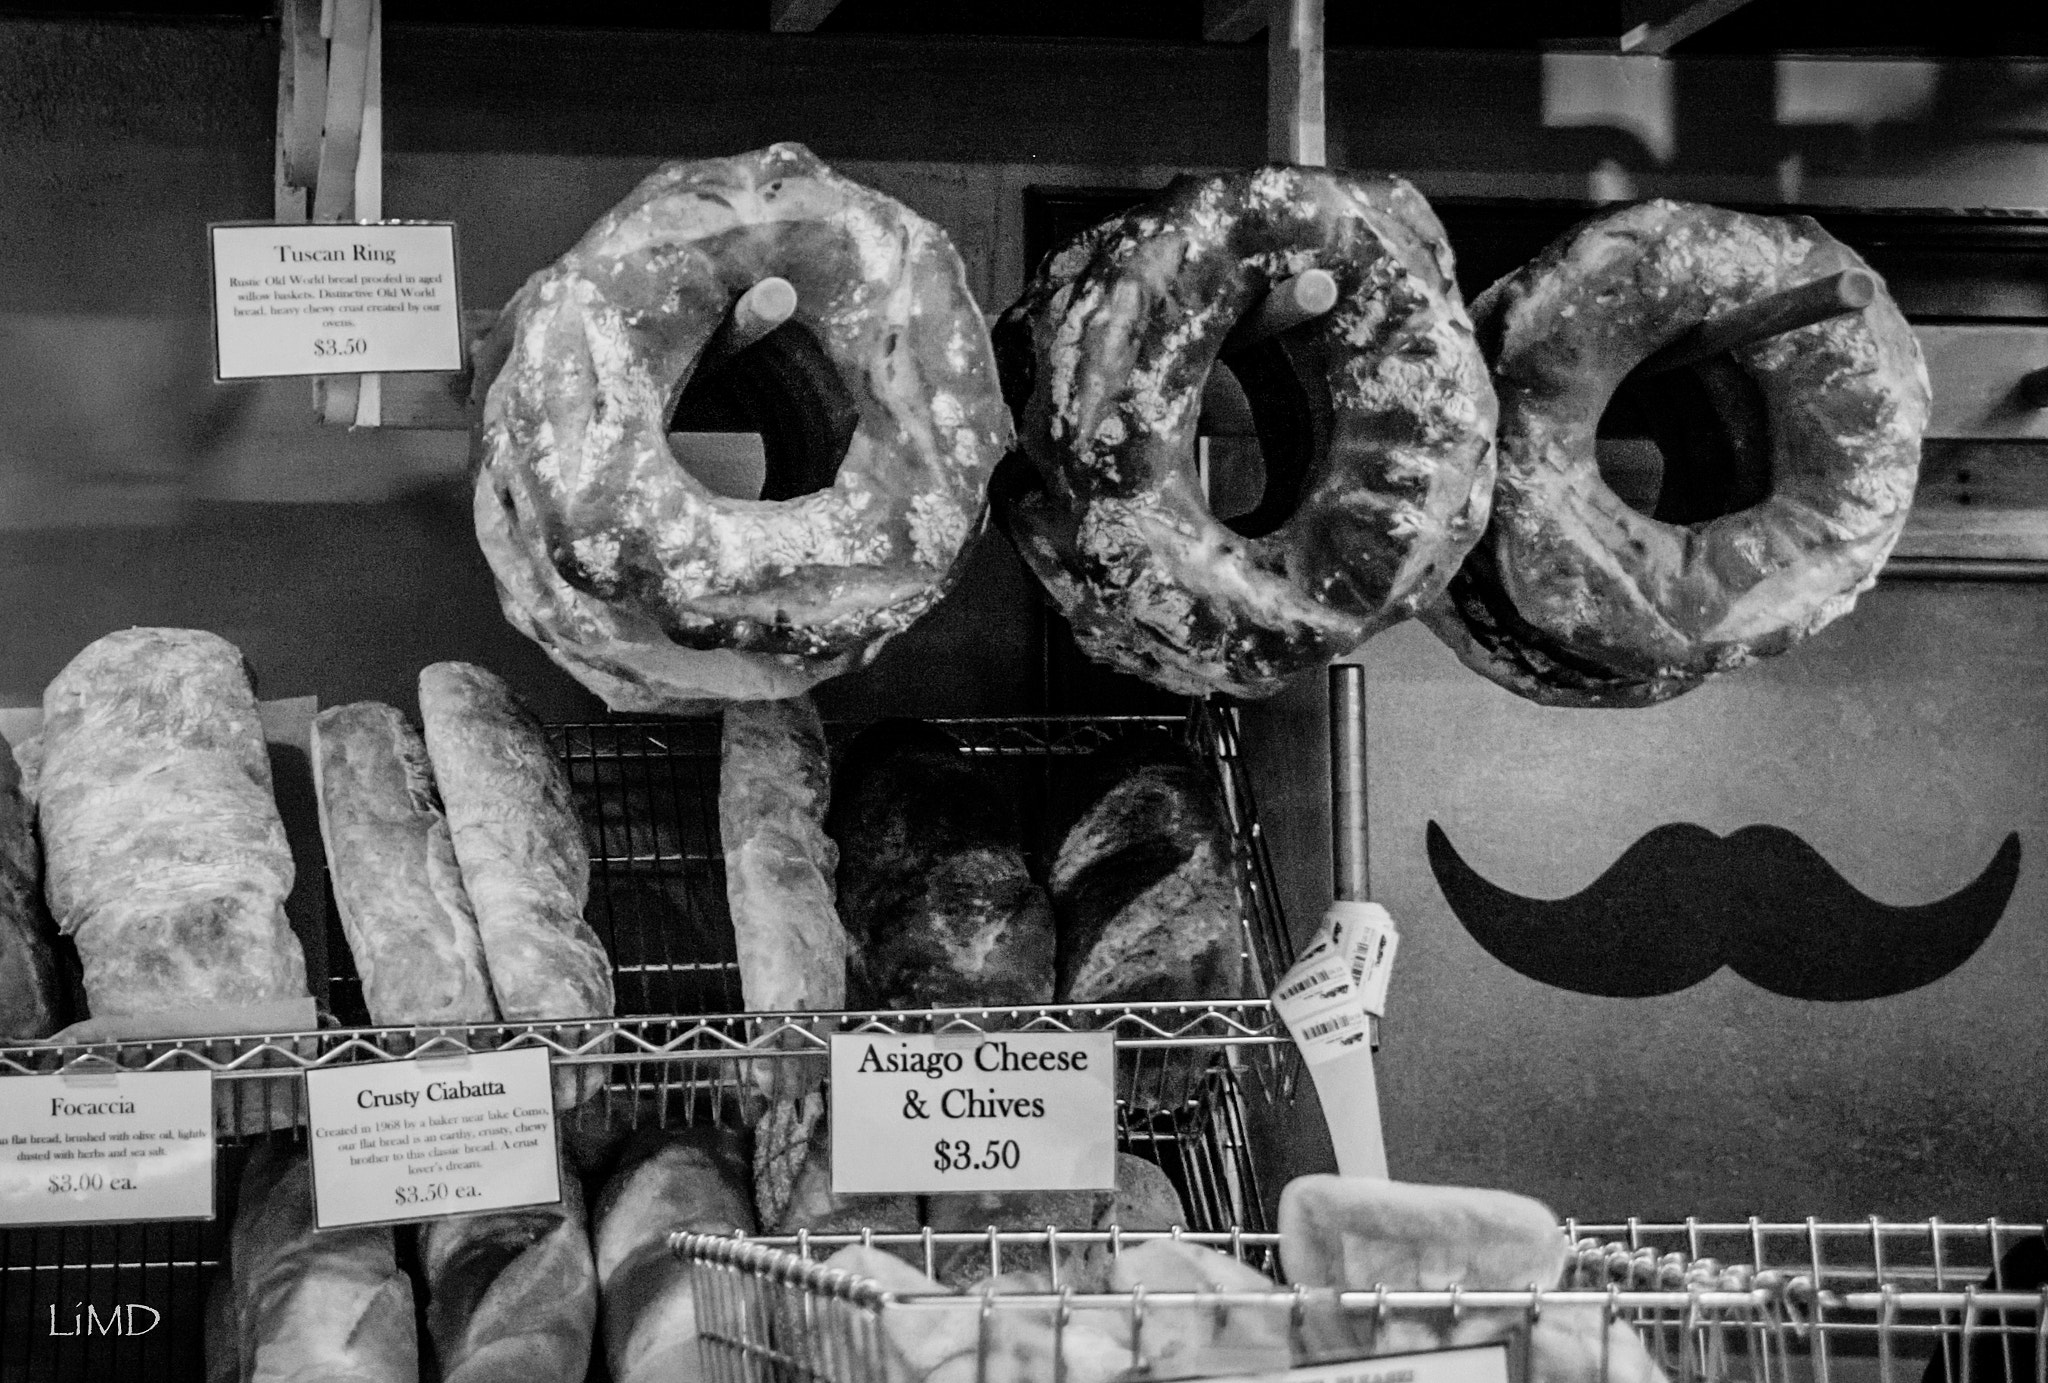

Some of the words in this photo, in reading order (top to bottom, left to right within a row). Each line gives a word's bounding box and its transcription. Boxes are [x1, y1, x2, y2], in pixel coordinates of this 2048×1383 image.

[273, 244, 345, 263] Tuscan
[352, 244, 397, 265] Ring
[229, 276, 260, 287] Rustic
[265, 275, 286, 286] Old
[289, 274, 325, 285] World
[328, 274, 357, 284] bread
[361, 273, 402, 286] proofed
[405, 275, 416, 284] in
[419, 273, 443, 286] aged
[238, 291, 270, 301] willow
[319, 288, 374, 299] Distinctive
[377, 287, 398, 298] Old
[401, 287, 436, 298] World
[270, 305, 299, 316] heavy
[303, 303, 335, 316] chewy
[339, 304, 364, 313] crust
[367, 302, 405, 313] created
[408, 302, 420, 314] by
[423, 304, 441, 313] our
[313, 337, 368, 357] $3.50
[857, 1043, 964, 1079] Asiago
[974, 1041, 1088, 1072] Cheese
[50, 1095, 136, 1117] Focaccia
[357, 1088, 421, 1110] Crusty
[426, 1080, 506, 1103] Ciabatta
[902, 1089, 930, 1119] &
[941, 1088, 1046, 1118] Chives
[316, 1123, 358, 1138] Created
[361, 1125, 371, 1133] in
[375, 1120, 401, 1133] 1968
[404, 1118, 416, 1131] by
[428, 1115, 458, 1127] baker
[461, 1114, 484, 1124] near
[487, 1109, 510, 1120] lake
[512, 1107, 550, 1118] Como,
[12, 1134, 27, 1145] flat
[65, 1131, 106, 1143] brushed
[108, 1130, 130, 1141] with
[132, 1129, 156, 1140] olive
[178, 1128, 207, 1142] lightly
[338, 1143, 356, 1152] our
[360, 1138, 376, 1150] flat
[379, 1134, 410, 1147] bread
[413, 1135, 421, 1144] is
[515, 1122, 548, 1134] chewy
[17, 1150, 51, 1161] dusted
[54, 1149, 75, 1160] with
[78, 1148, 105, 1159] herbs
[108, 1147, 127, 1158] and
[130, 1149, 146, 1157] sea
[350, 1153, 390, 1166] brother
[393, 1152, 404, 1161] to
[407, 1149, 426, 1160] this
[428, 1147, 460, 1158] classic
[502, 1140, 510, 1150] A
[513, 1138, 539, 1149] crust
[933, 1138, 1021, 1174] $3.50
[408, 1161, 443, 1175] lover's
[48, 1172, 103, 1195] $3.00
[110, 1178, 137, 1191] ea.
[395, 1182, 448, 1206] $3.50
[455, 1185, 482, 1199] ea.
